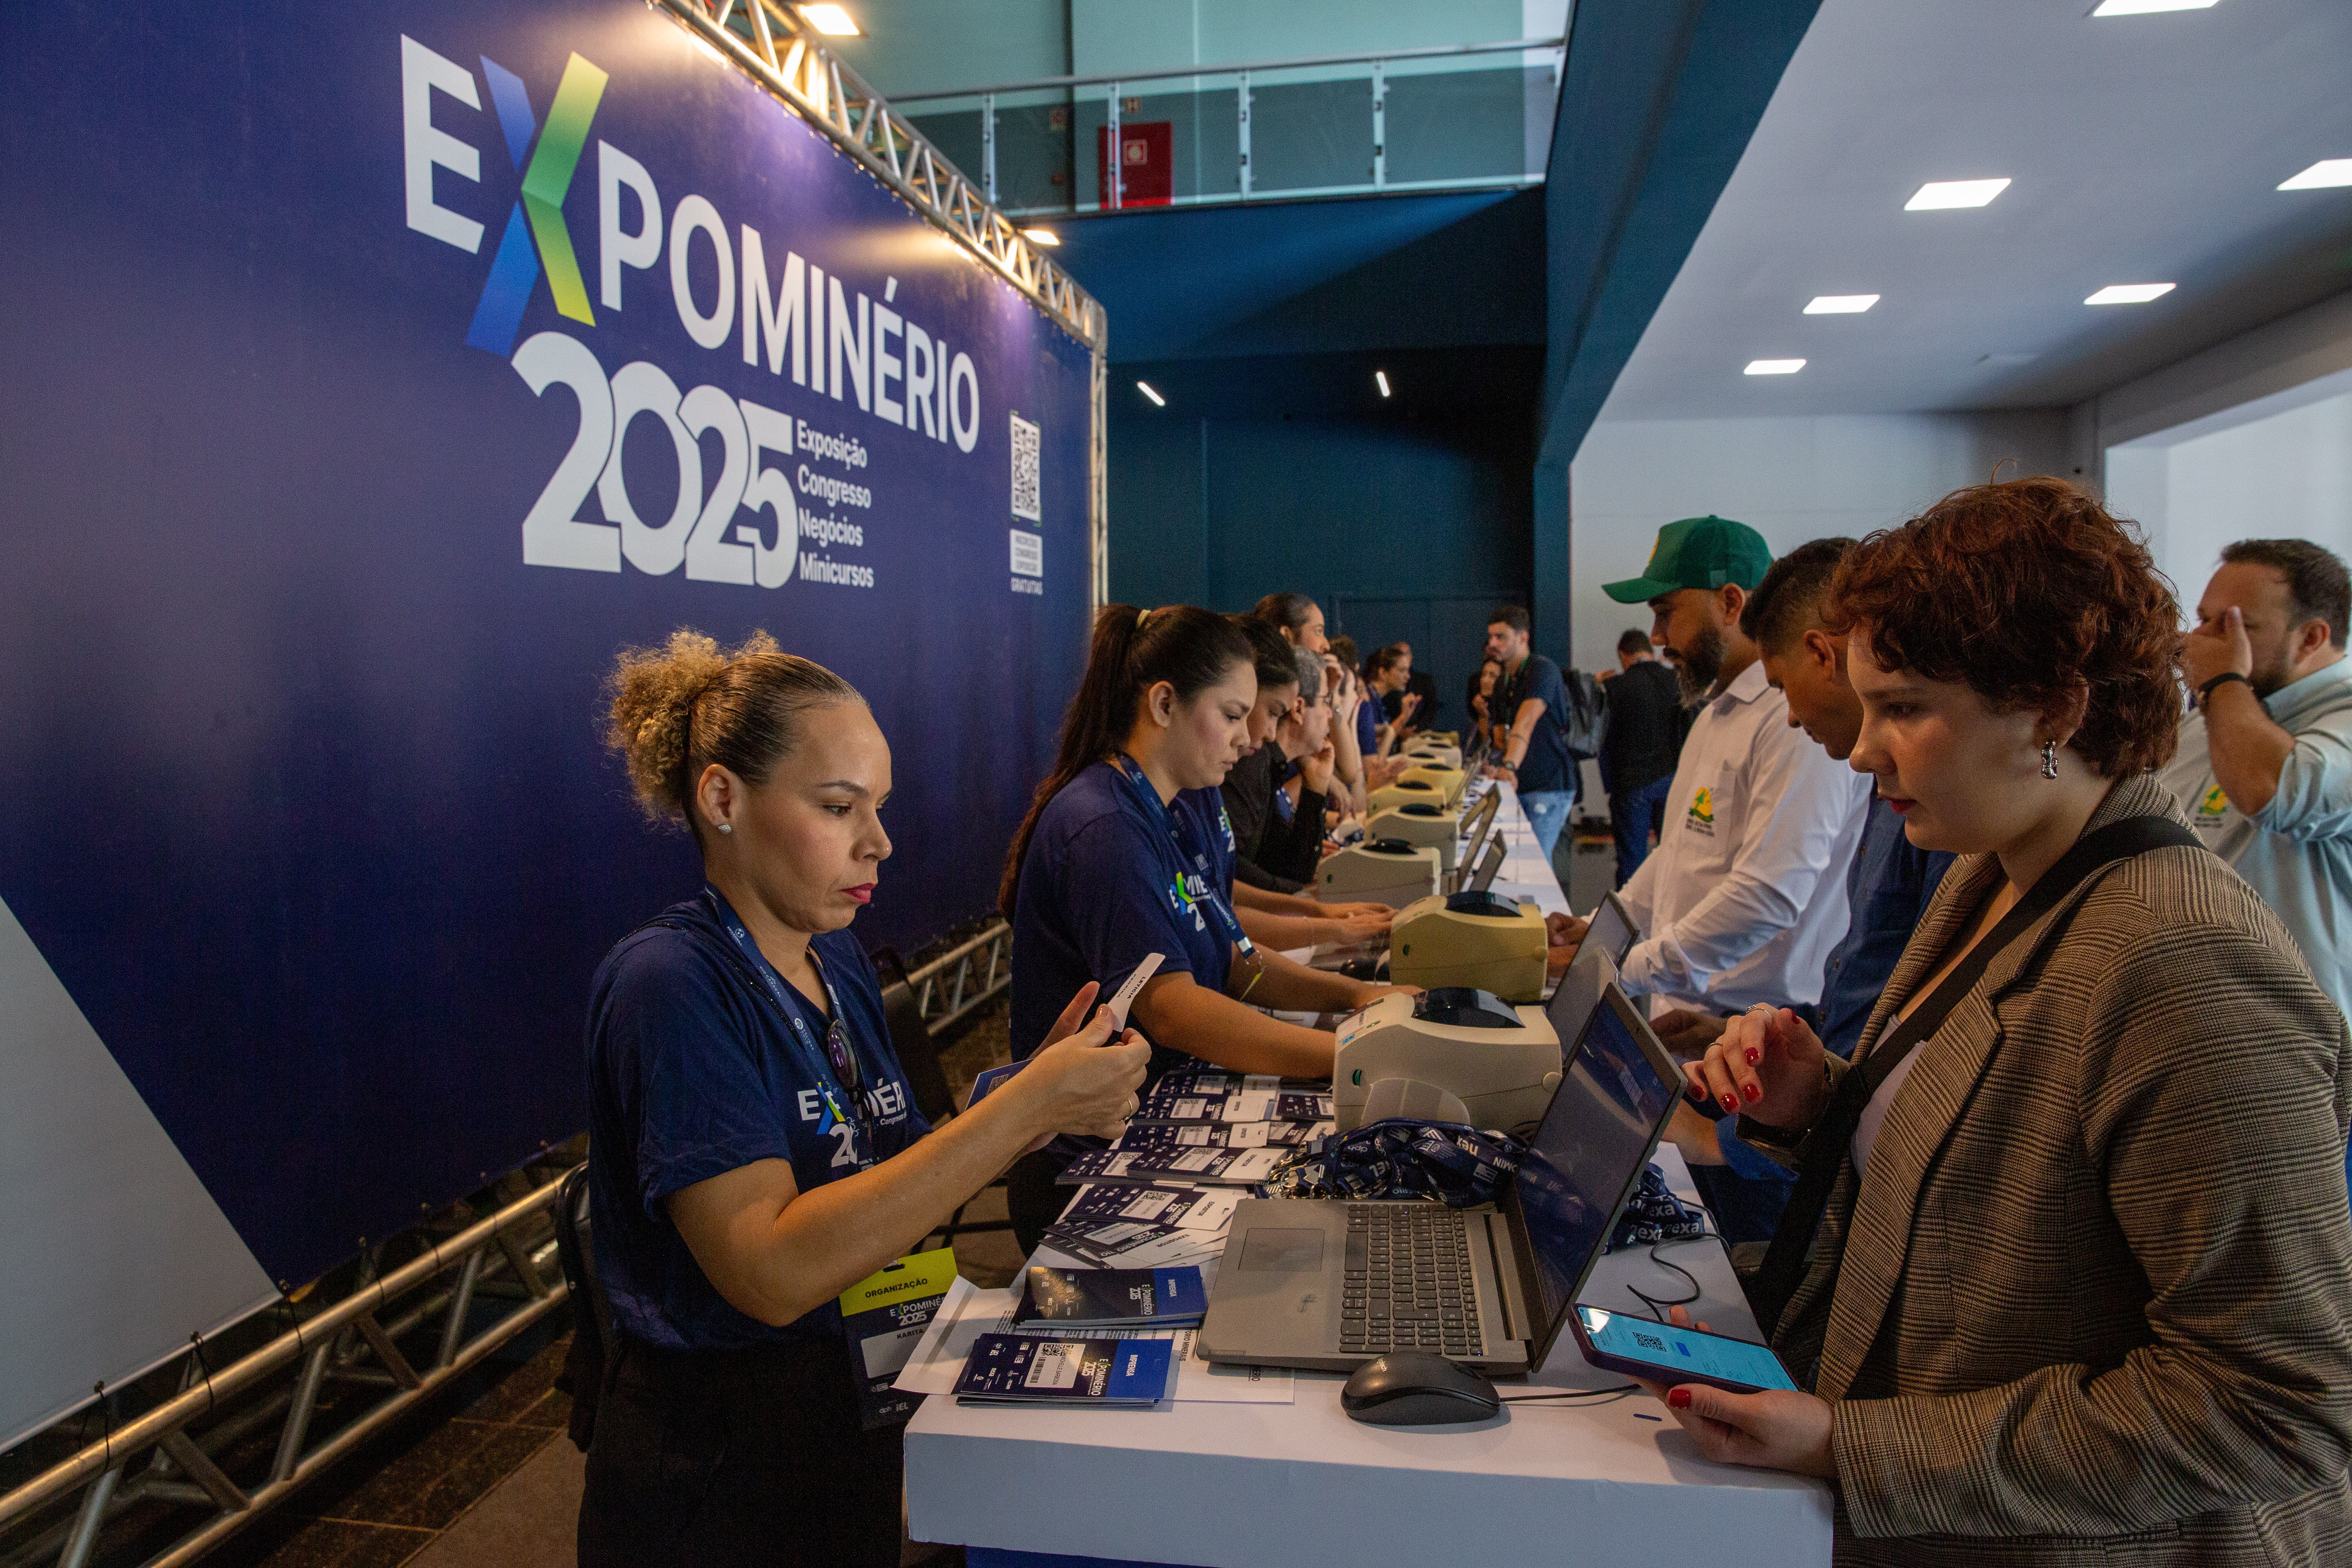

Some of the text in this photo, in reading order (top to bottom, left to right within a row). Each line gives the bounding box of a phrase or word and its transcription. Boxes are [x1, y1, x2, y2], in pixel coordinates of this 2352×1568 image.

[401, 34, 980, 454] EXPOMINÉRIO
[797, 418, 868, 471] Exposição
[511, 331, 799, 589] 2025
[797, 464, 872, 509] Congresso
[798, 507, 864, 548] Negócios
[799, 551, 874, 588] Minicursos
[1127, 976, 1146, 999] LETICIA
[1156, 1234, 1190, 1248] EXPOSITOR
[865, 1278, 928, 1298] ORGANIZAÇÃO
[1168, 1279, 1177, 1297] IMPRENSA
[898, 1311, 928, 1327] 2025
[1178, 1341, 1190, 1361] MINERAIS
[1081, 1361, 1098, 1377] 2025
[1126, 1354, 1138, 1377] IMPRENSA
[1051, 1370, 1062, 1385] BARBOSA
